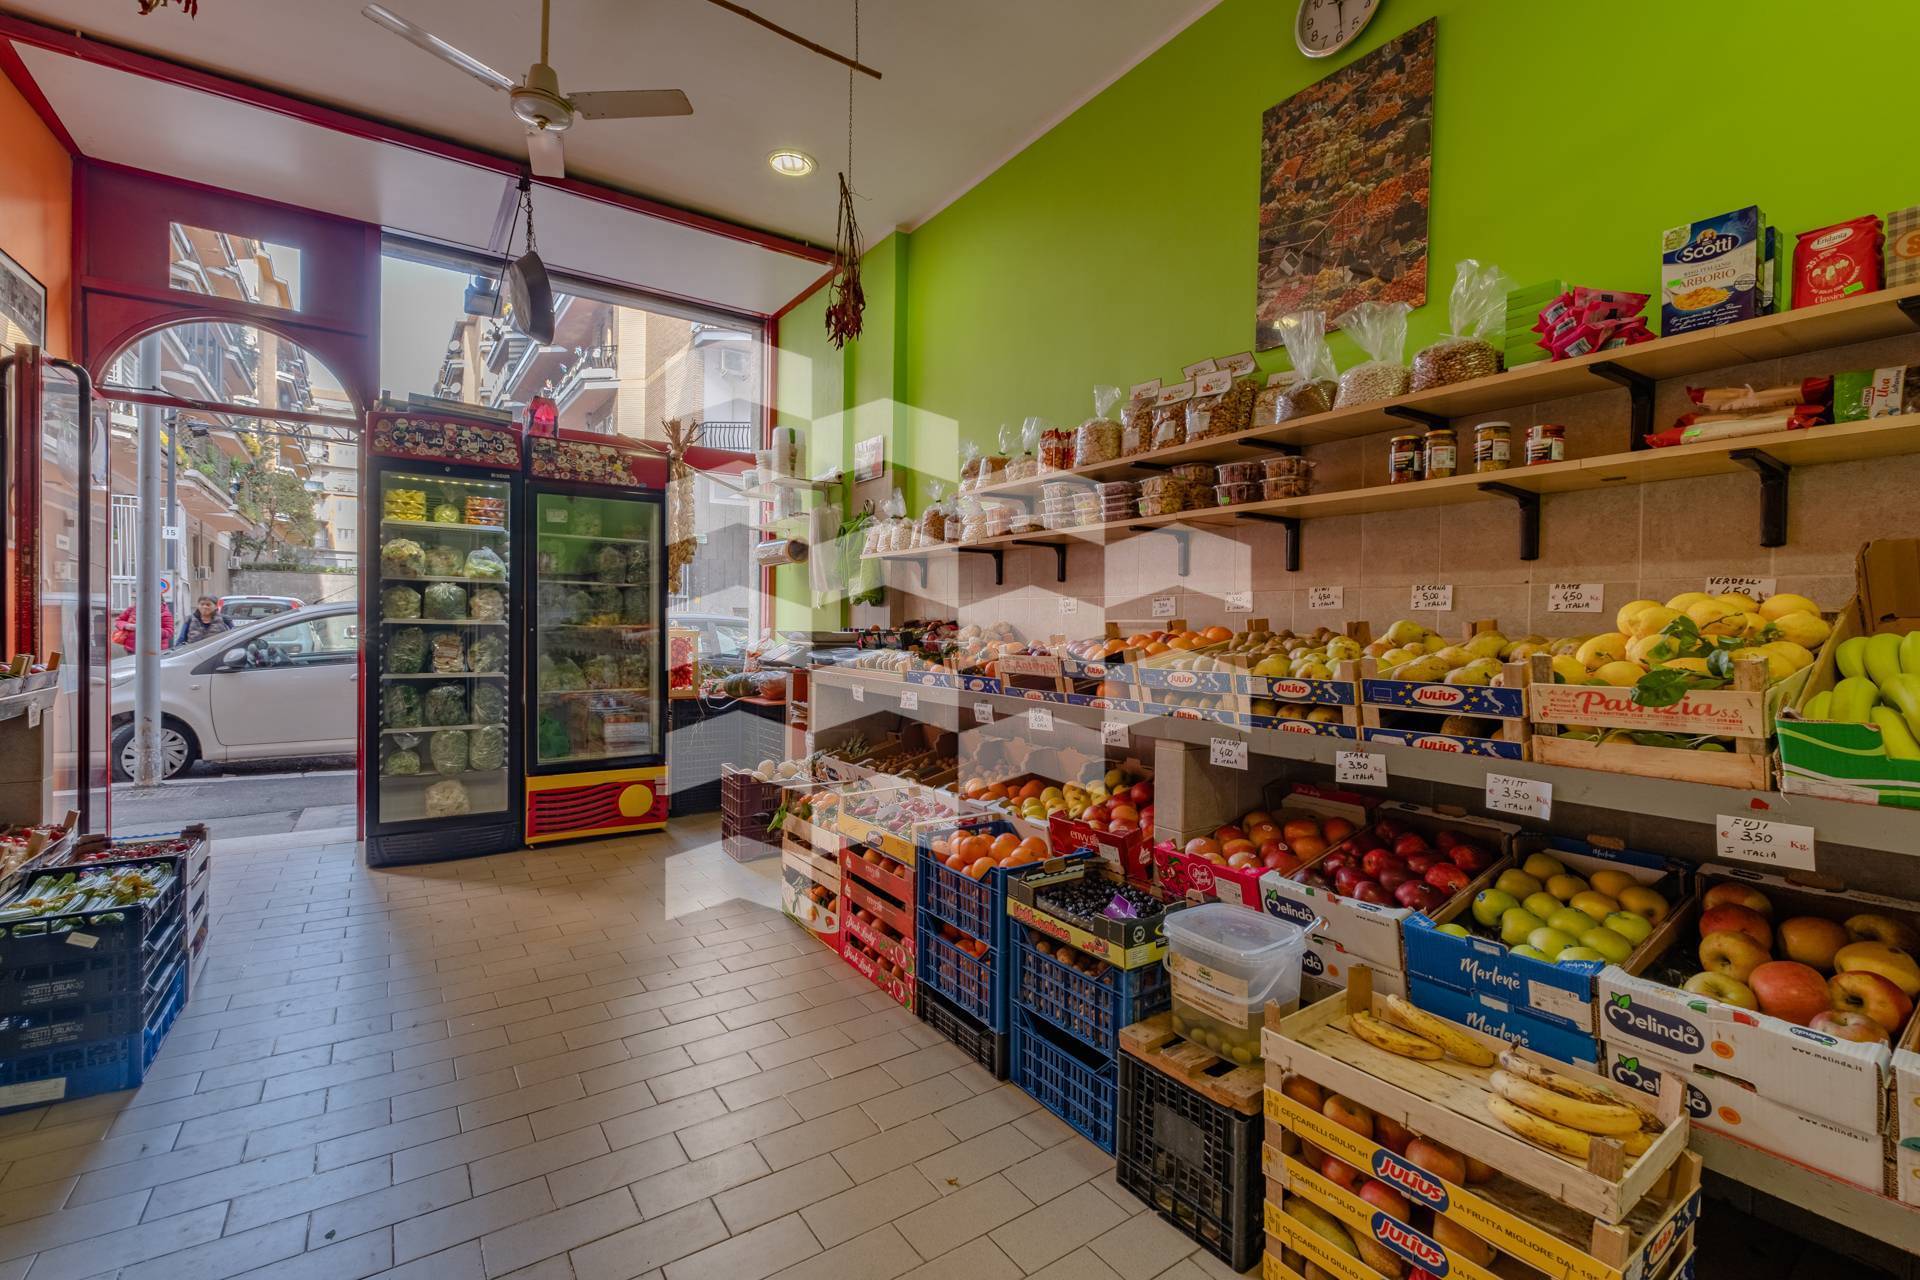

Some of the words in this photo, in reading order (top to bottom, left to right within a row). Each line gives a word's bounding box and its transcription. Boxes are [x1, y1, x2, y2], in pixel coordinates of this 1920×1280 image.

[1307, 18, 1314, 30] 9
[1312, 30, 1319, 42] 8
[1321, 35, 1329, 48] 7
[1336, 31, 1344, 43] 6
[1682, 236, 1733, 262] Scotti
[1678, 268, 1736, 289] ARBORIO
[1876, 378, 1890, 398] Uva
[1170, 674, 1193, 684] JULIUS
[1277, 683, 1307, 695] JULIUS
[1418, 689, 1458, 702] JULIUS
[1731, 818, 1769, 831] FUJI
[1070, 830, 1089, 844] envy
[1743, 850, 1777, 859] ITALIA
[1193, 867, 1209, 878] Pink
[1267, 899, 1313, 922] Melinda
[1460, 957, 1521, 992] Marlene
[1608, 1004, 1700, 1048] Melinda
[1281, 1107, 1328, 1138] CECCARELLI
[1329, 1131, 1358, 1154] GIULIO
[1358, 1150, 1369, 1160] srl
[1379, 1156, 1445, 1201] JULIUS
[1379, 1219, 1445, 1265] JULIUS
[1453, 1201, 1466, 1212] LA
[1466, 1208, 1503, 1233] FRUTTA
[1505, 1228, 1555, 1261] MIGLIORE
[1556, 1256, 1578, 1274] DAL
[1283, 1225, 1329, 1261] CECCARELLI
[1331, 1255, 1360, 1280] GIULIO
